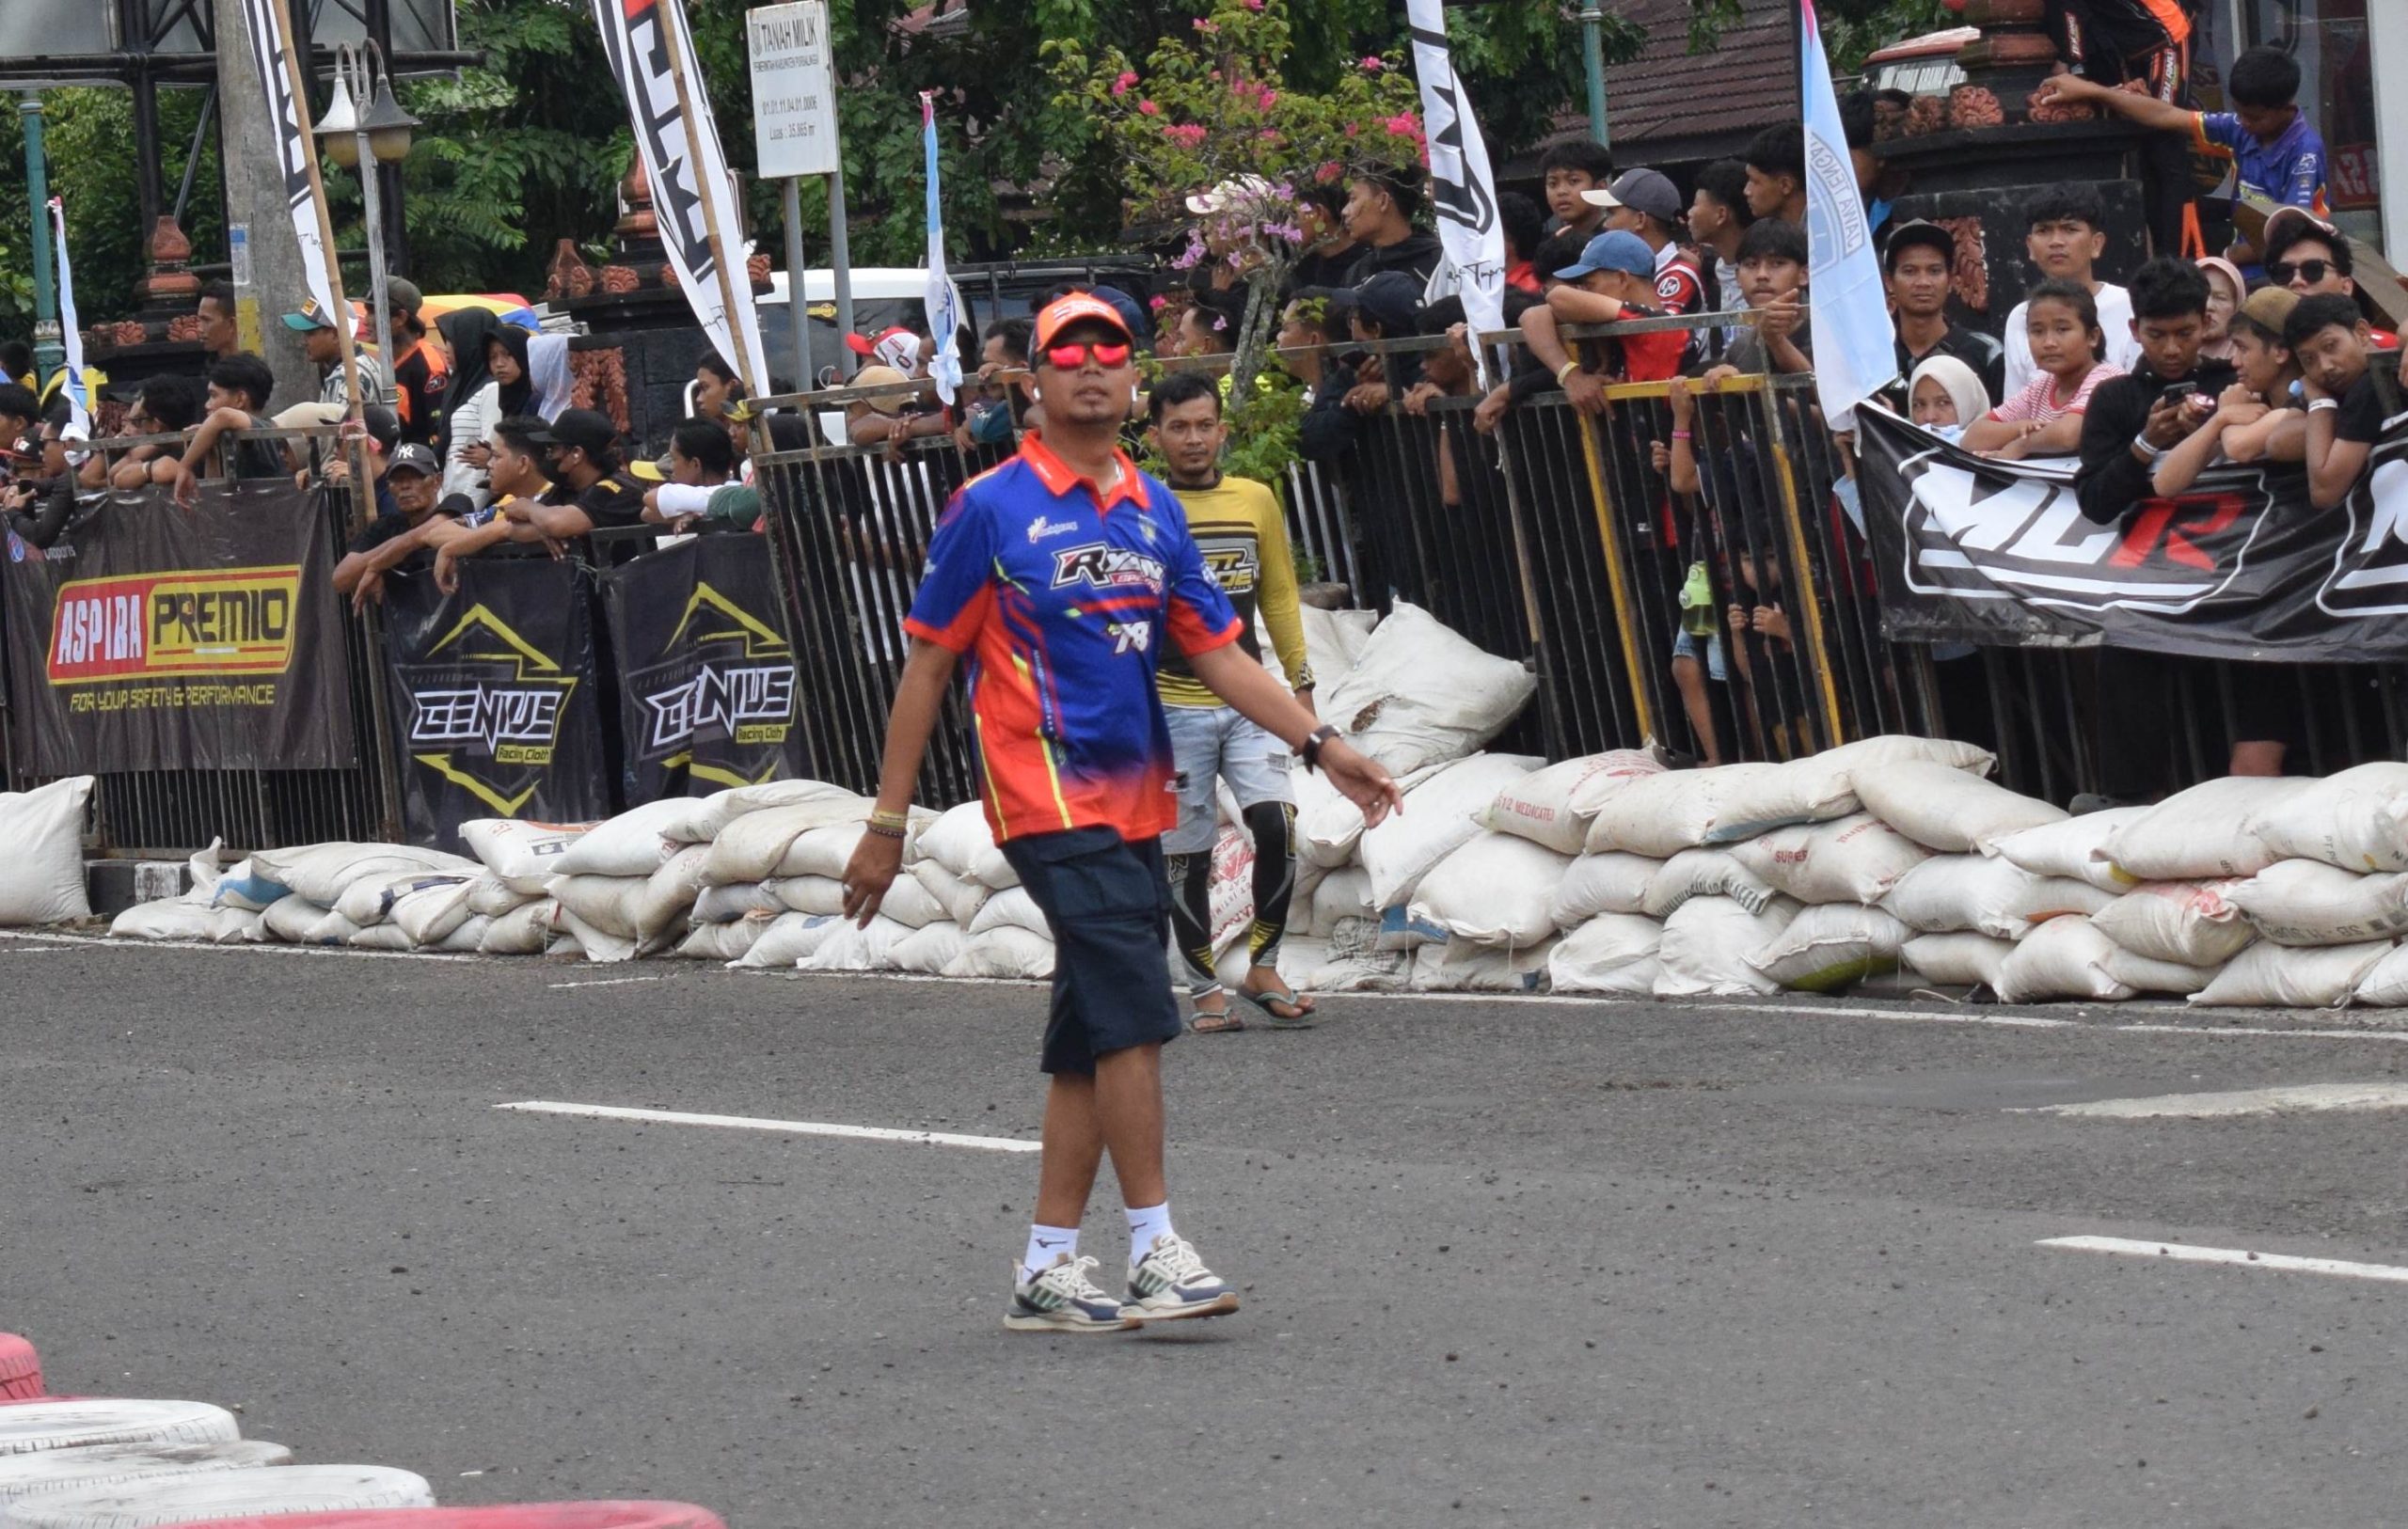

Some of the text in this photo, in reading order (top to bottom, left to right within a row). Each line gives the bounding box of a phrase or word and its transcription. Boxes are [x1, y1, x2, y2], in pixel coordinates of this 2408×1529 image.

[761, 17, 817, 53] TANAH MILIK
[398, 445, 415, 459] NY
[1911, 461, 2246, 571] MLR
[1051, 543, 1164, 588] RYAN
[56, 588, 289, 664] ASPIRA PREMIO
[70, 685, 275, 712] FOR YOUR SAFETY & PERFORMANCE
[412, 682, 562, 755] GENIUS
[524, 748, 548, 761] Cloth
